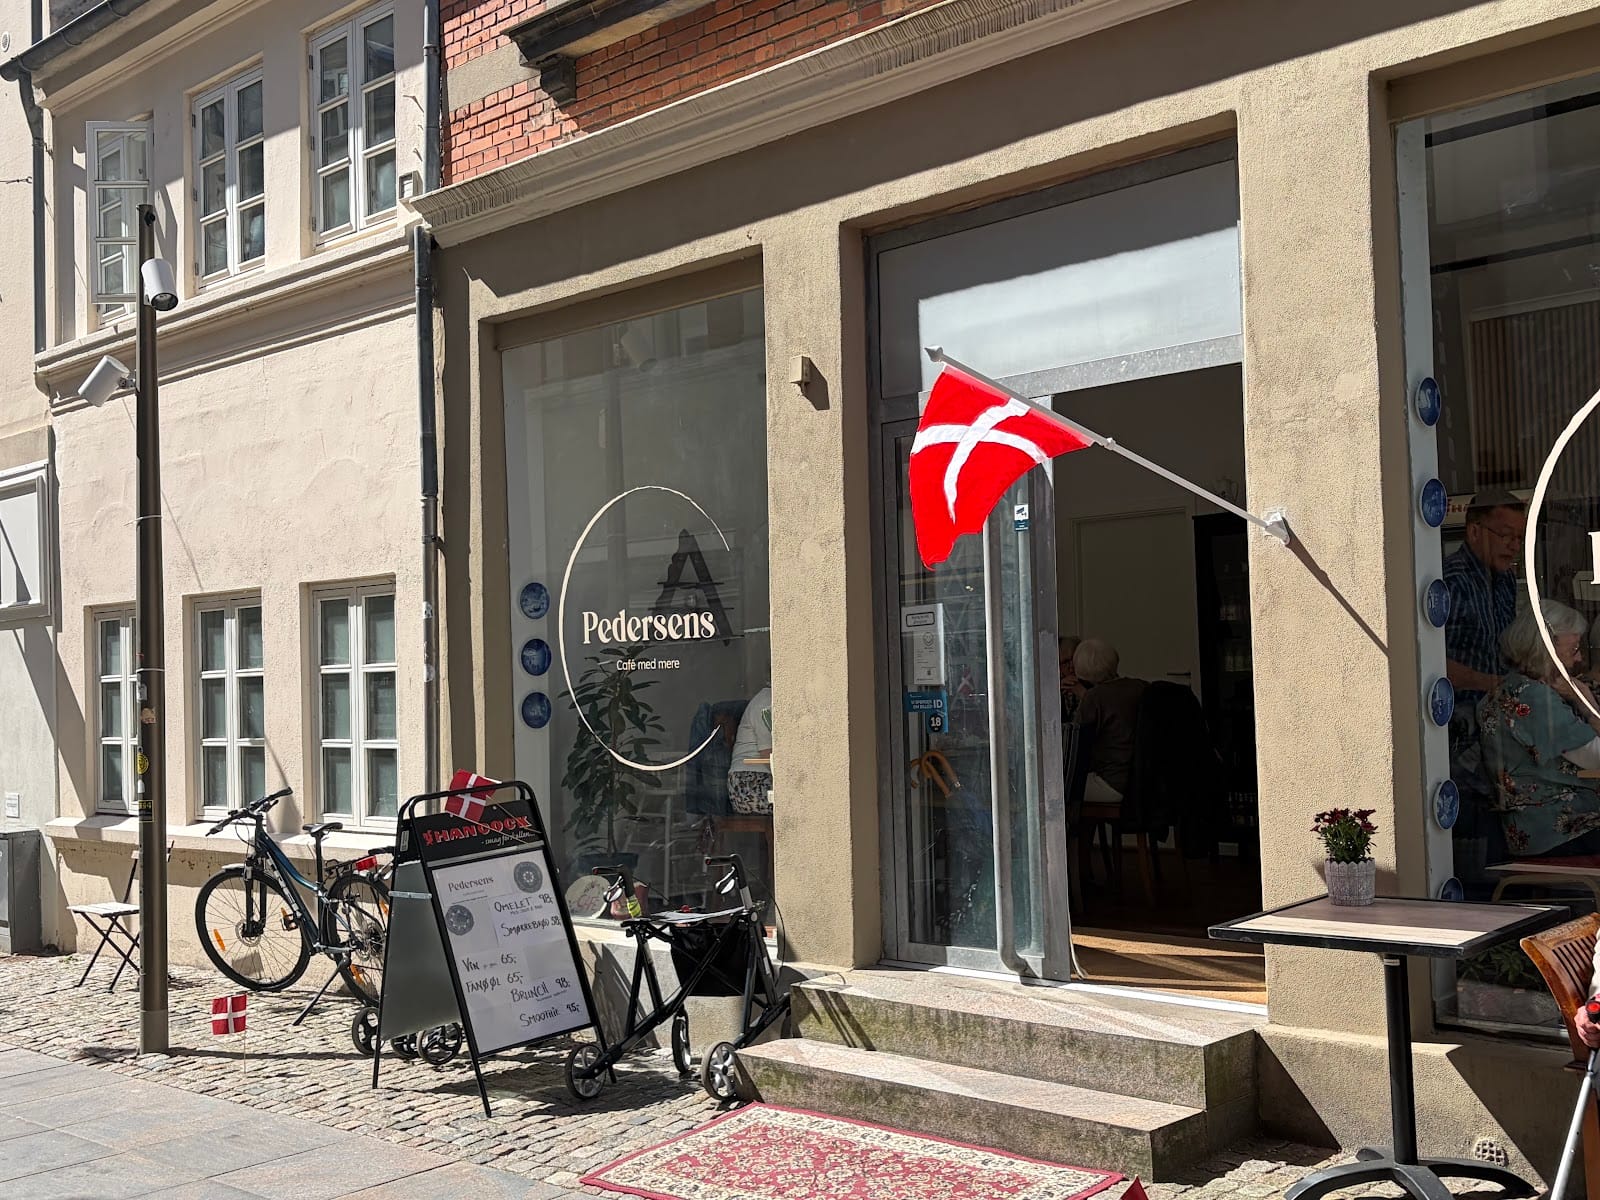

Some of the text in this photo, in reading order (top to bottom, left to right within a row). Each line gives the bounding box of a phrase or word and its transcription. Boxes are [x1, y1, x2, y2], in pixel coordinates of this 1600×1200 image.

[582, 609, 716, 644] Pedersens
[616, 658, 680, 671] Café med mere
[933, 699, 943, 709] ID
[930, 716, 942, 727] 18
[434, 815, 532, 843] HANCOCK
[448, 877, 494, 892] Pedersens
[494, 896, 532, 912] OMELET
[510, 981, 549, 1002] BRUNCH
